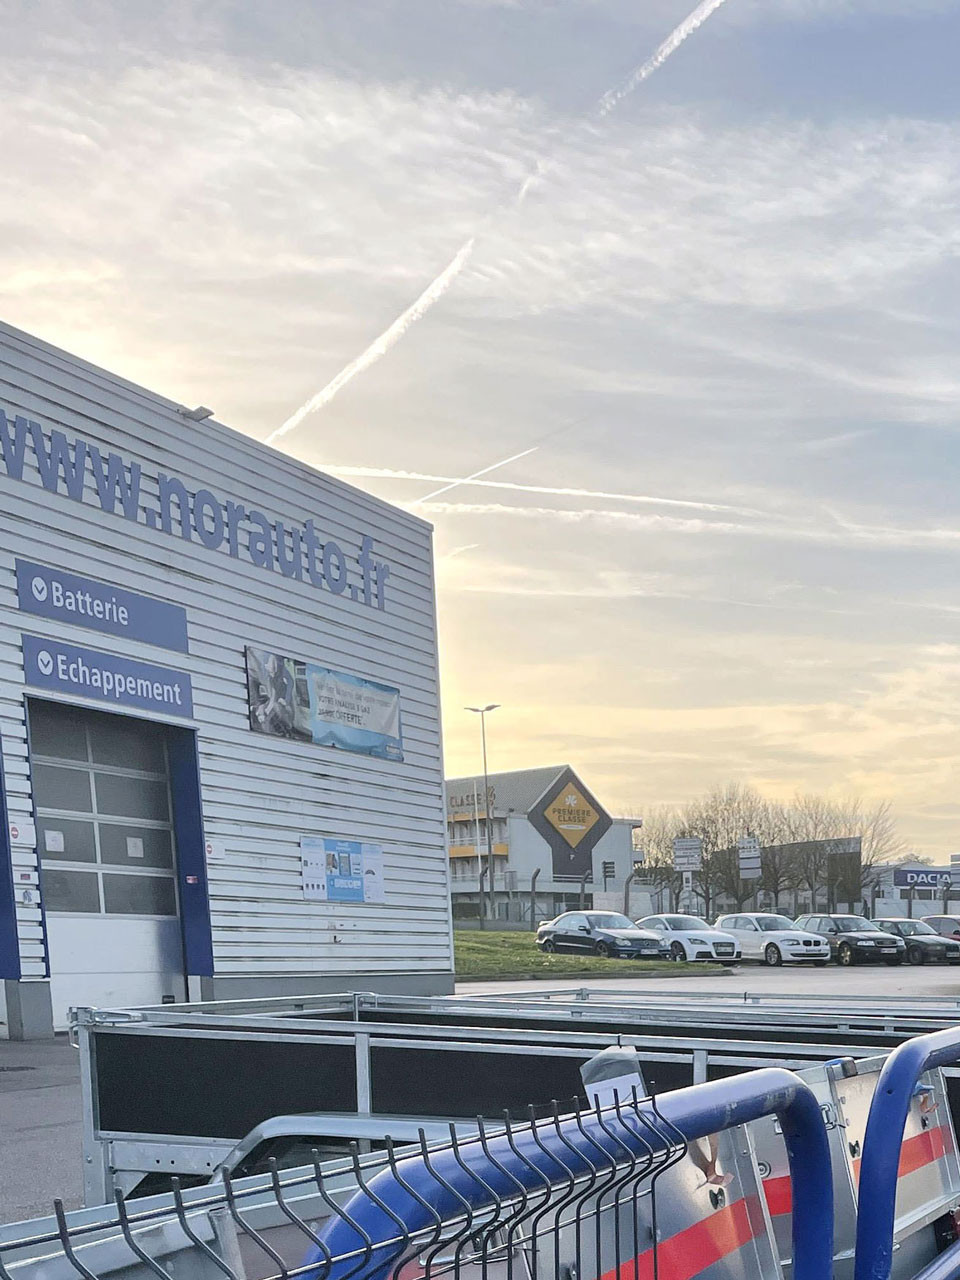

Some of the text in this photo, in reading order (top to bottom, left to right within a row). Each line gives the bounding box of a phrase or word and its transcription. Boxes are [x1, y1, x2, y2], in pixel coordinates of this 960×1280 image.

[51, 581, 129, 626] Batterie
[56, 654, 182, 706] Echappement
[552, 807, 591, 817] PREMIERE
[558, 815, 586, 824] CLASSE
[907, 873, 951, 884] DACIA
